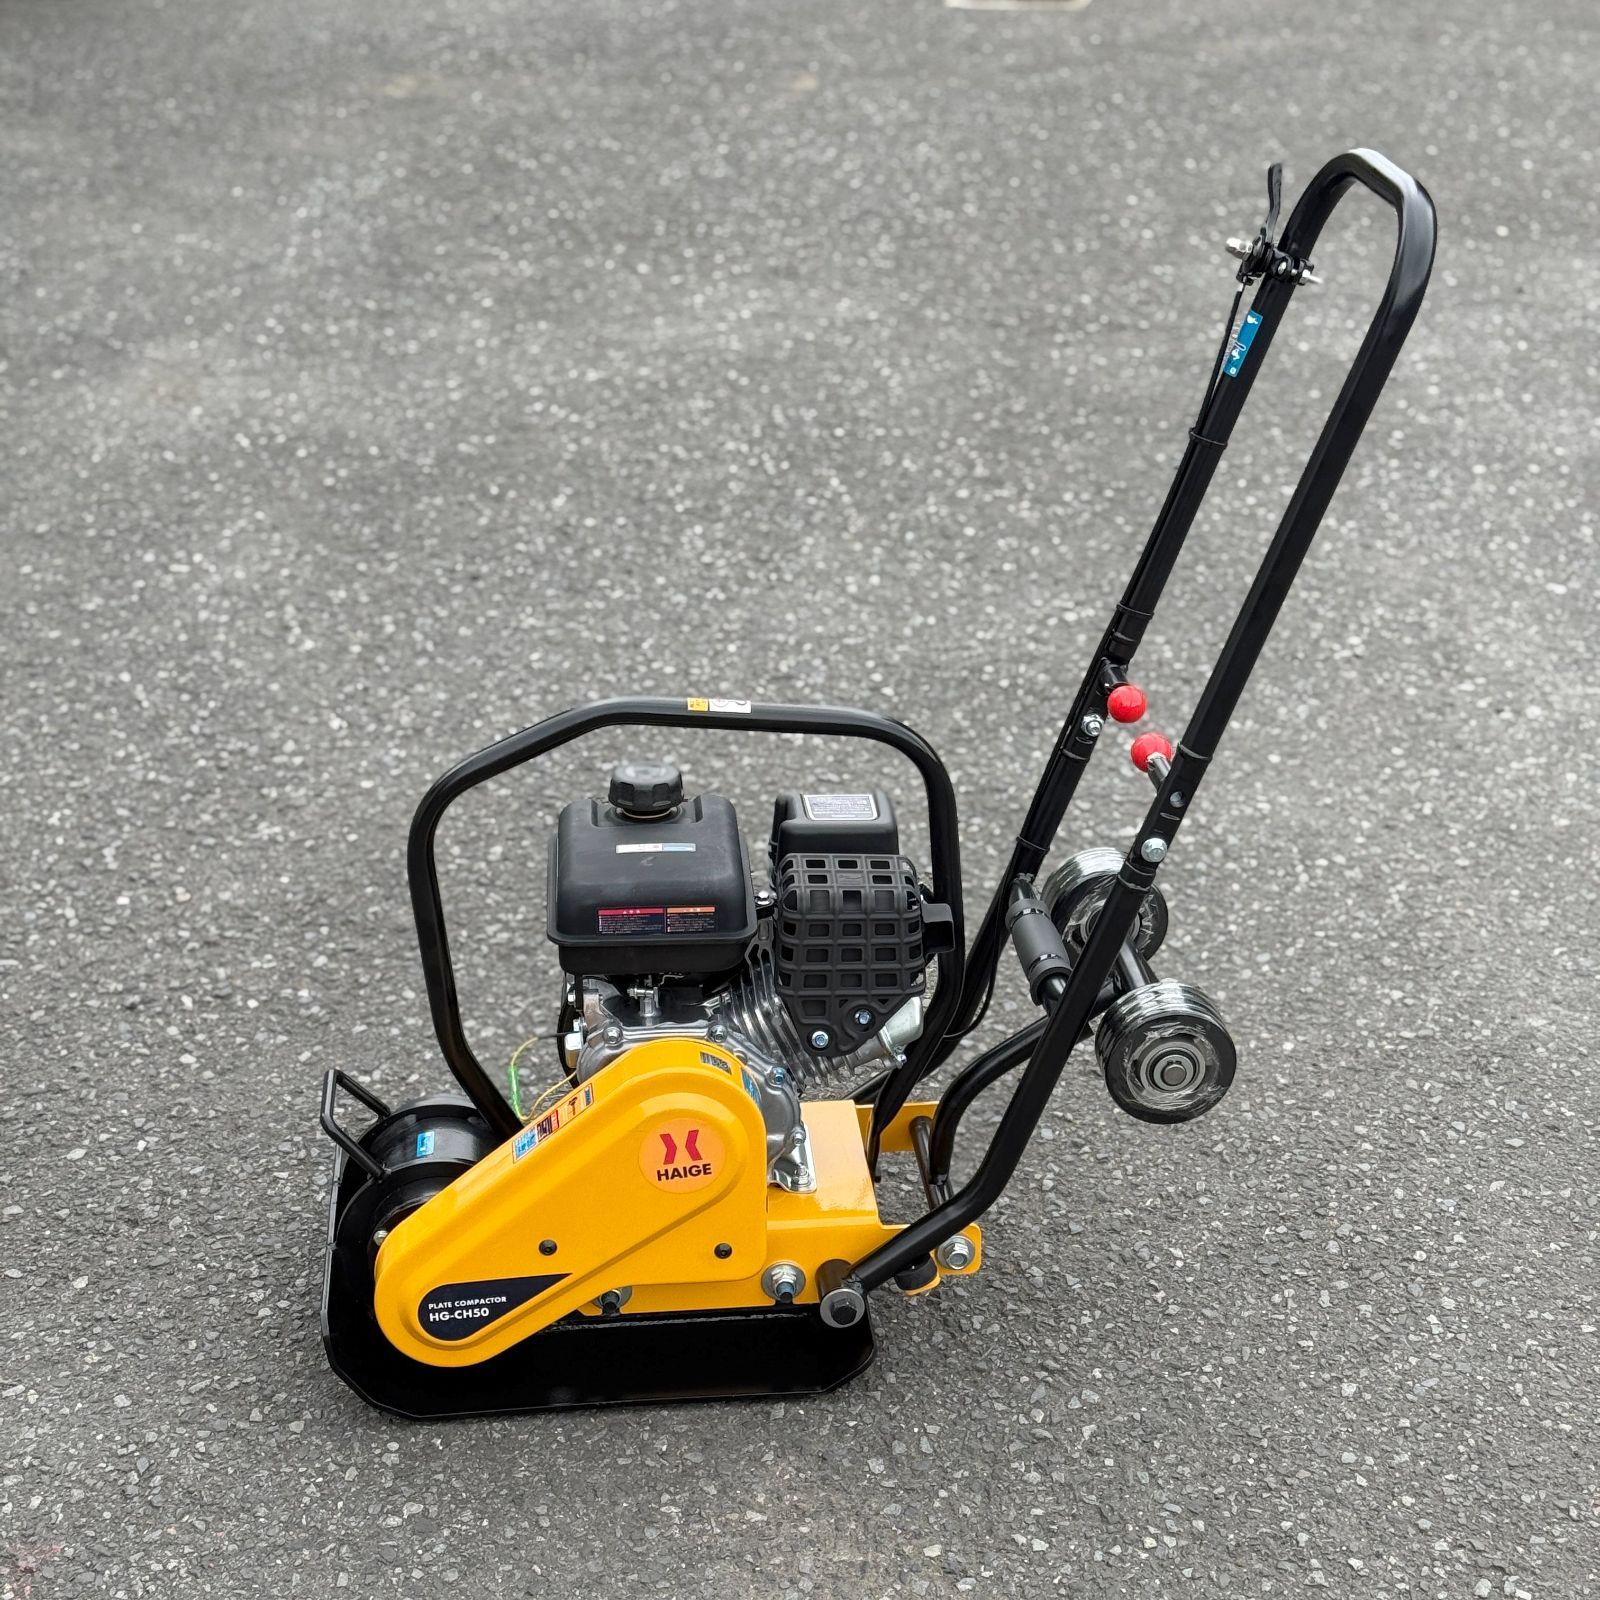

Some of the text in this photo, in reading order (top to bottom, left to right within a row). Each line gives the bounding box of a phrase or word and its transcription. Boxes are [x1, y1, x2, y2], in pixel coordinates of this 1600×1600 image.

[656, 1163, 712, 1182] HAIGE
[428, 1296, 507, 1310] PLATE COMPACTOR
[429, 1307, 490, 1322] HG-CH50
